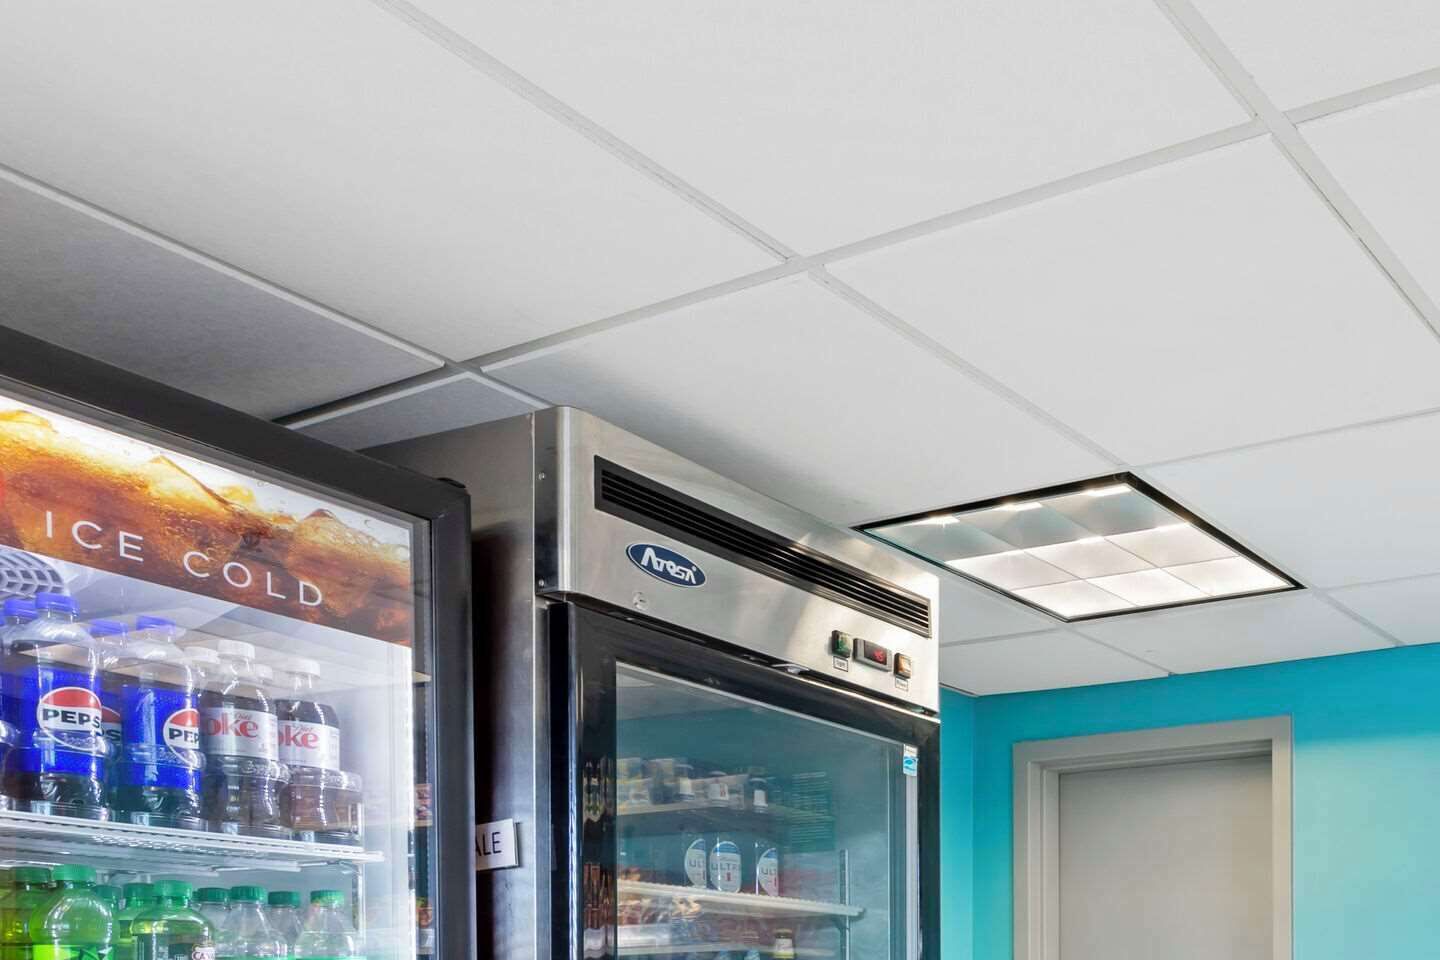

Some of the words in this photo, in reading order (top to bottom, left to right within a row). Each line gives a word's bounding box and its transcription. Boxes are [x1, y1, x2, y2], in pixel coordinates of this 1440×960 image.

[45, 511, 145, 562] ICE
[183, 551, 324, 607] COLD
[42, 708, 101, 731] PEPS
